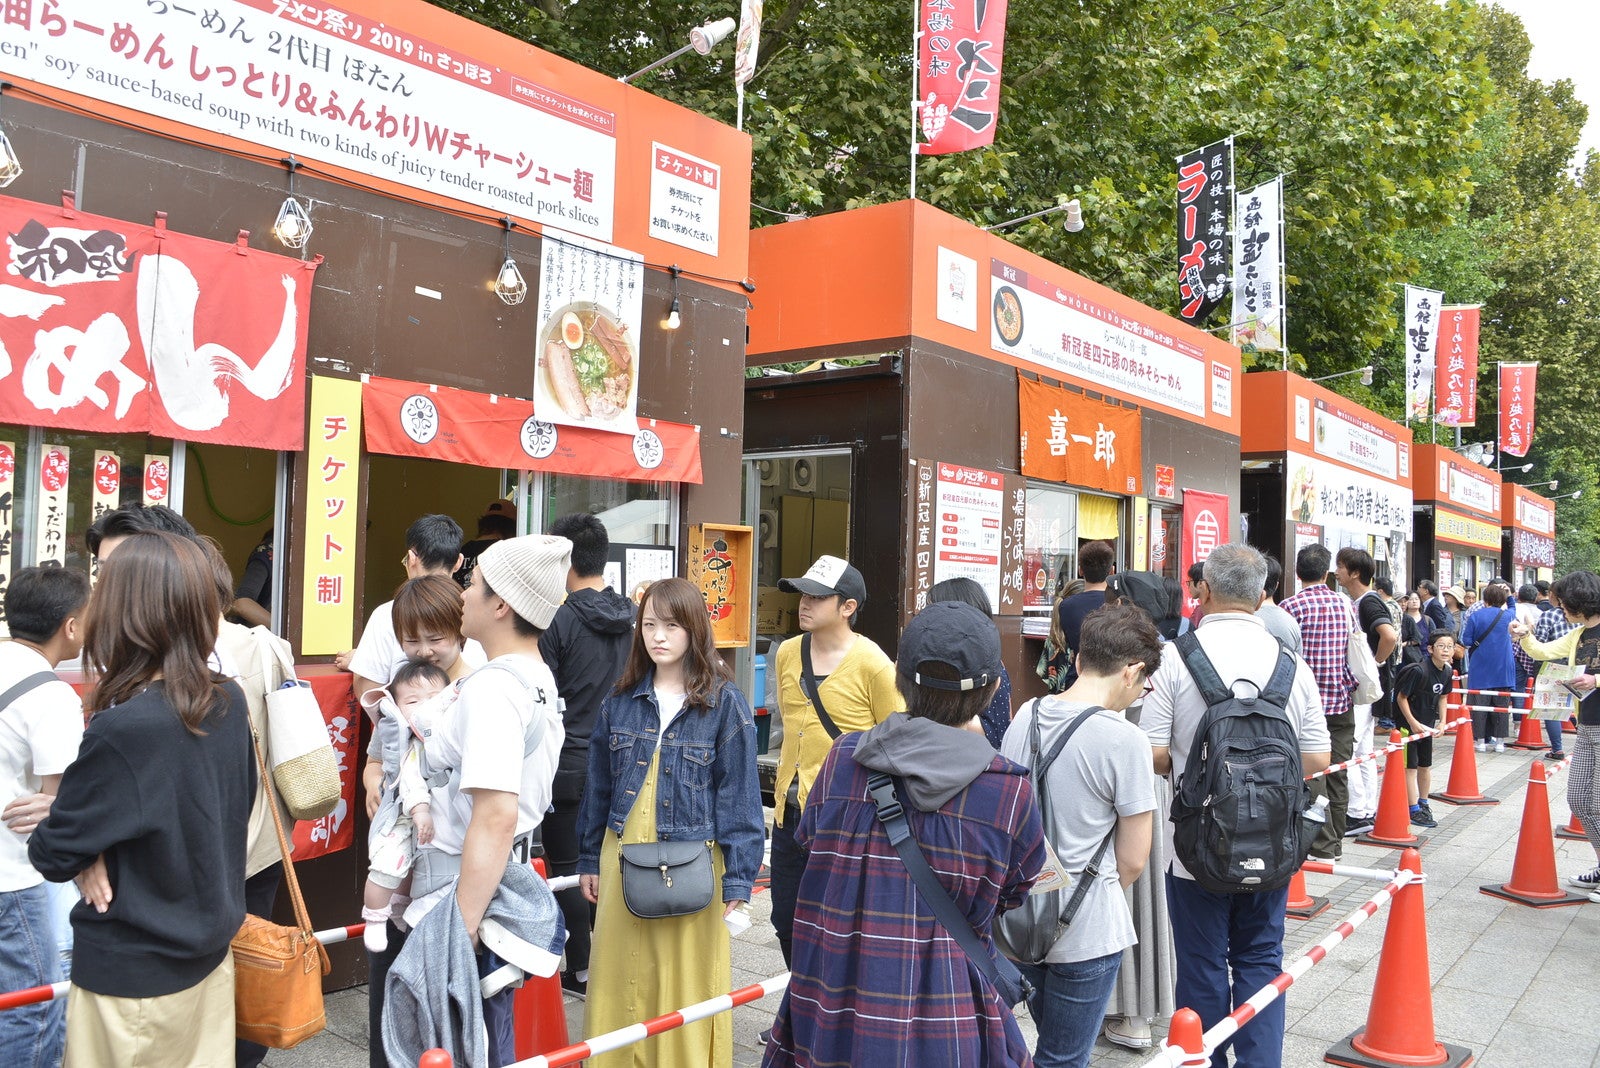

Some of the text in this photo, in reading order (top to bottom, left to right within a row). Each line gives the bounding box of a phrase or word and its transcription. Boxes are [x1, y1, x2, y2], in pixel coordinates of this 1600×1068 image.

[267, 31, 332, 73] 2代目
[343, 54, 414, 97] ぼたん
[369, 28, 415, 56] 2019
[418, 46, 433, 65] in
[436, 52, 493, 86] さっぽろ
[45, 54, 80, 79] soy
[86, 66, 203, 111] sauce-based
[209, 102, 251, 129] soup
[256, 115, 294, 138] with
[300, 127, 331, 148] two
[335, 134, 377, 162] kinds
[382, 150, 400, 168] of
[398, 154, 437, 183] juicy
[440, 168, 485, 193] tender
[488, 182, 534, 207] roasted
[537, 197, 566, 216] pork
[568, 207, 600, 228] slices
[659, 154, 715, 187] チケット制
[652, 216, 714, 243] お買い求めください
[670, 205, 702, 223] チケットを
[1208, 153, 1226, 267] 匠の技・本場の味
[1068, 296, 1119, 325] HOKKAIDO
[1061, 332, 1182, 391] 新冠産四元豚の肉みそらーめん
[1045, 408, 1117, 471] 喜一郎
[316, 415, 347, 605] チケット制
